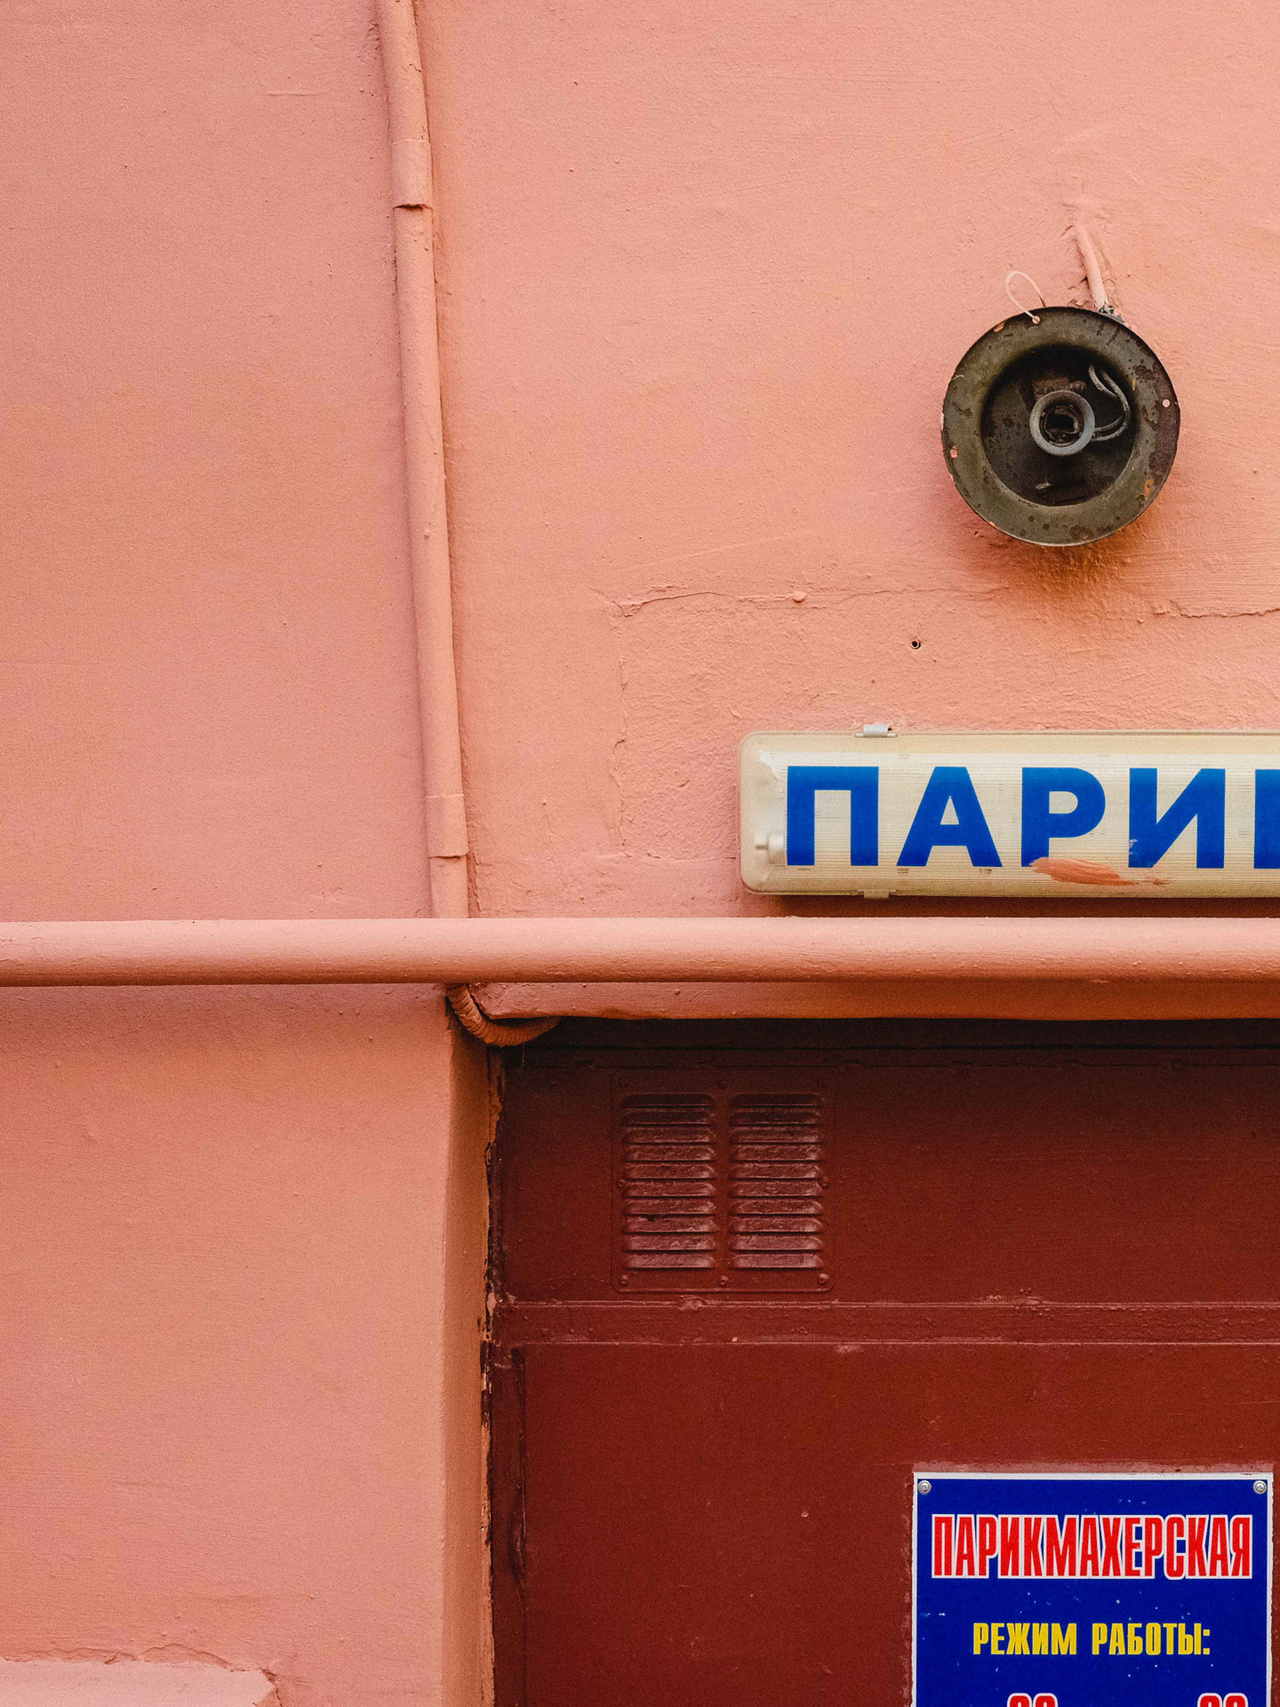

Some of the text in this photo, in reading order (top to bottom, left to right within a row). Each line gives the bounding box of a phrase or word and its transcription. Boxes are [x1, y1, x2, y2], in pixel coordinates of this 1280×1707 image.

[931, 1513, 1253, 1580] ПАРИКМАХЕРСКАЯ
[972, 1622, 1211, 1656] РЕЖИМ РАБОТЫ:
